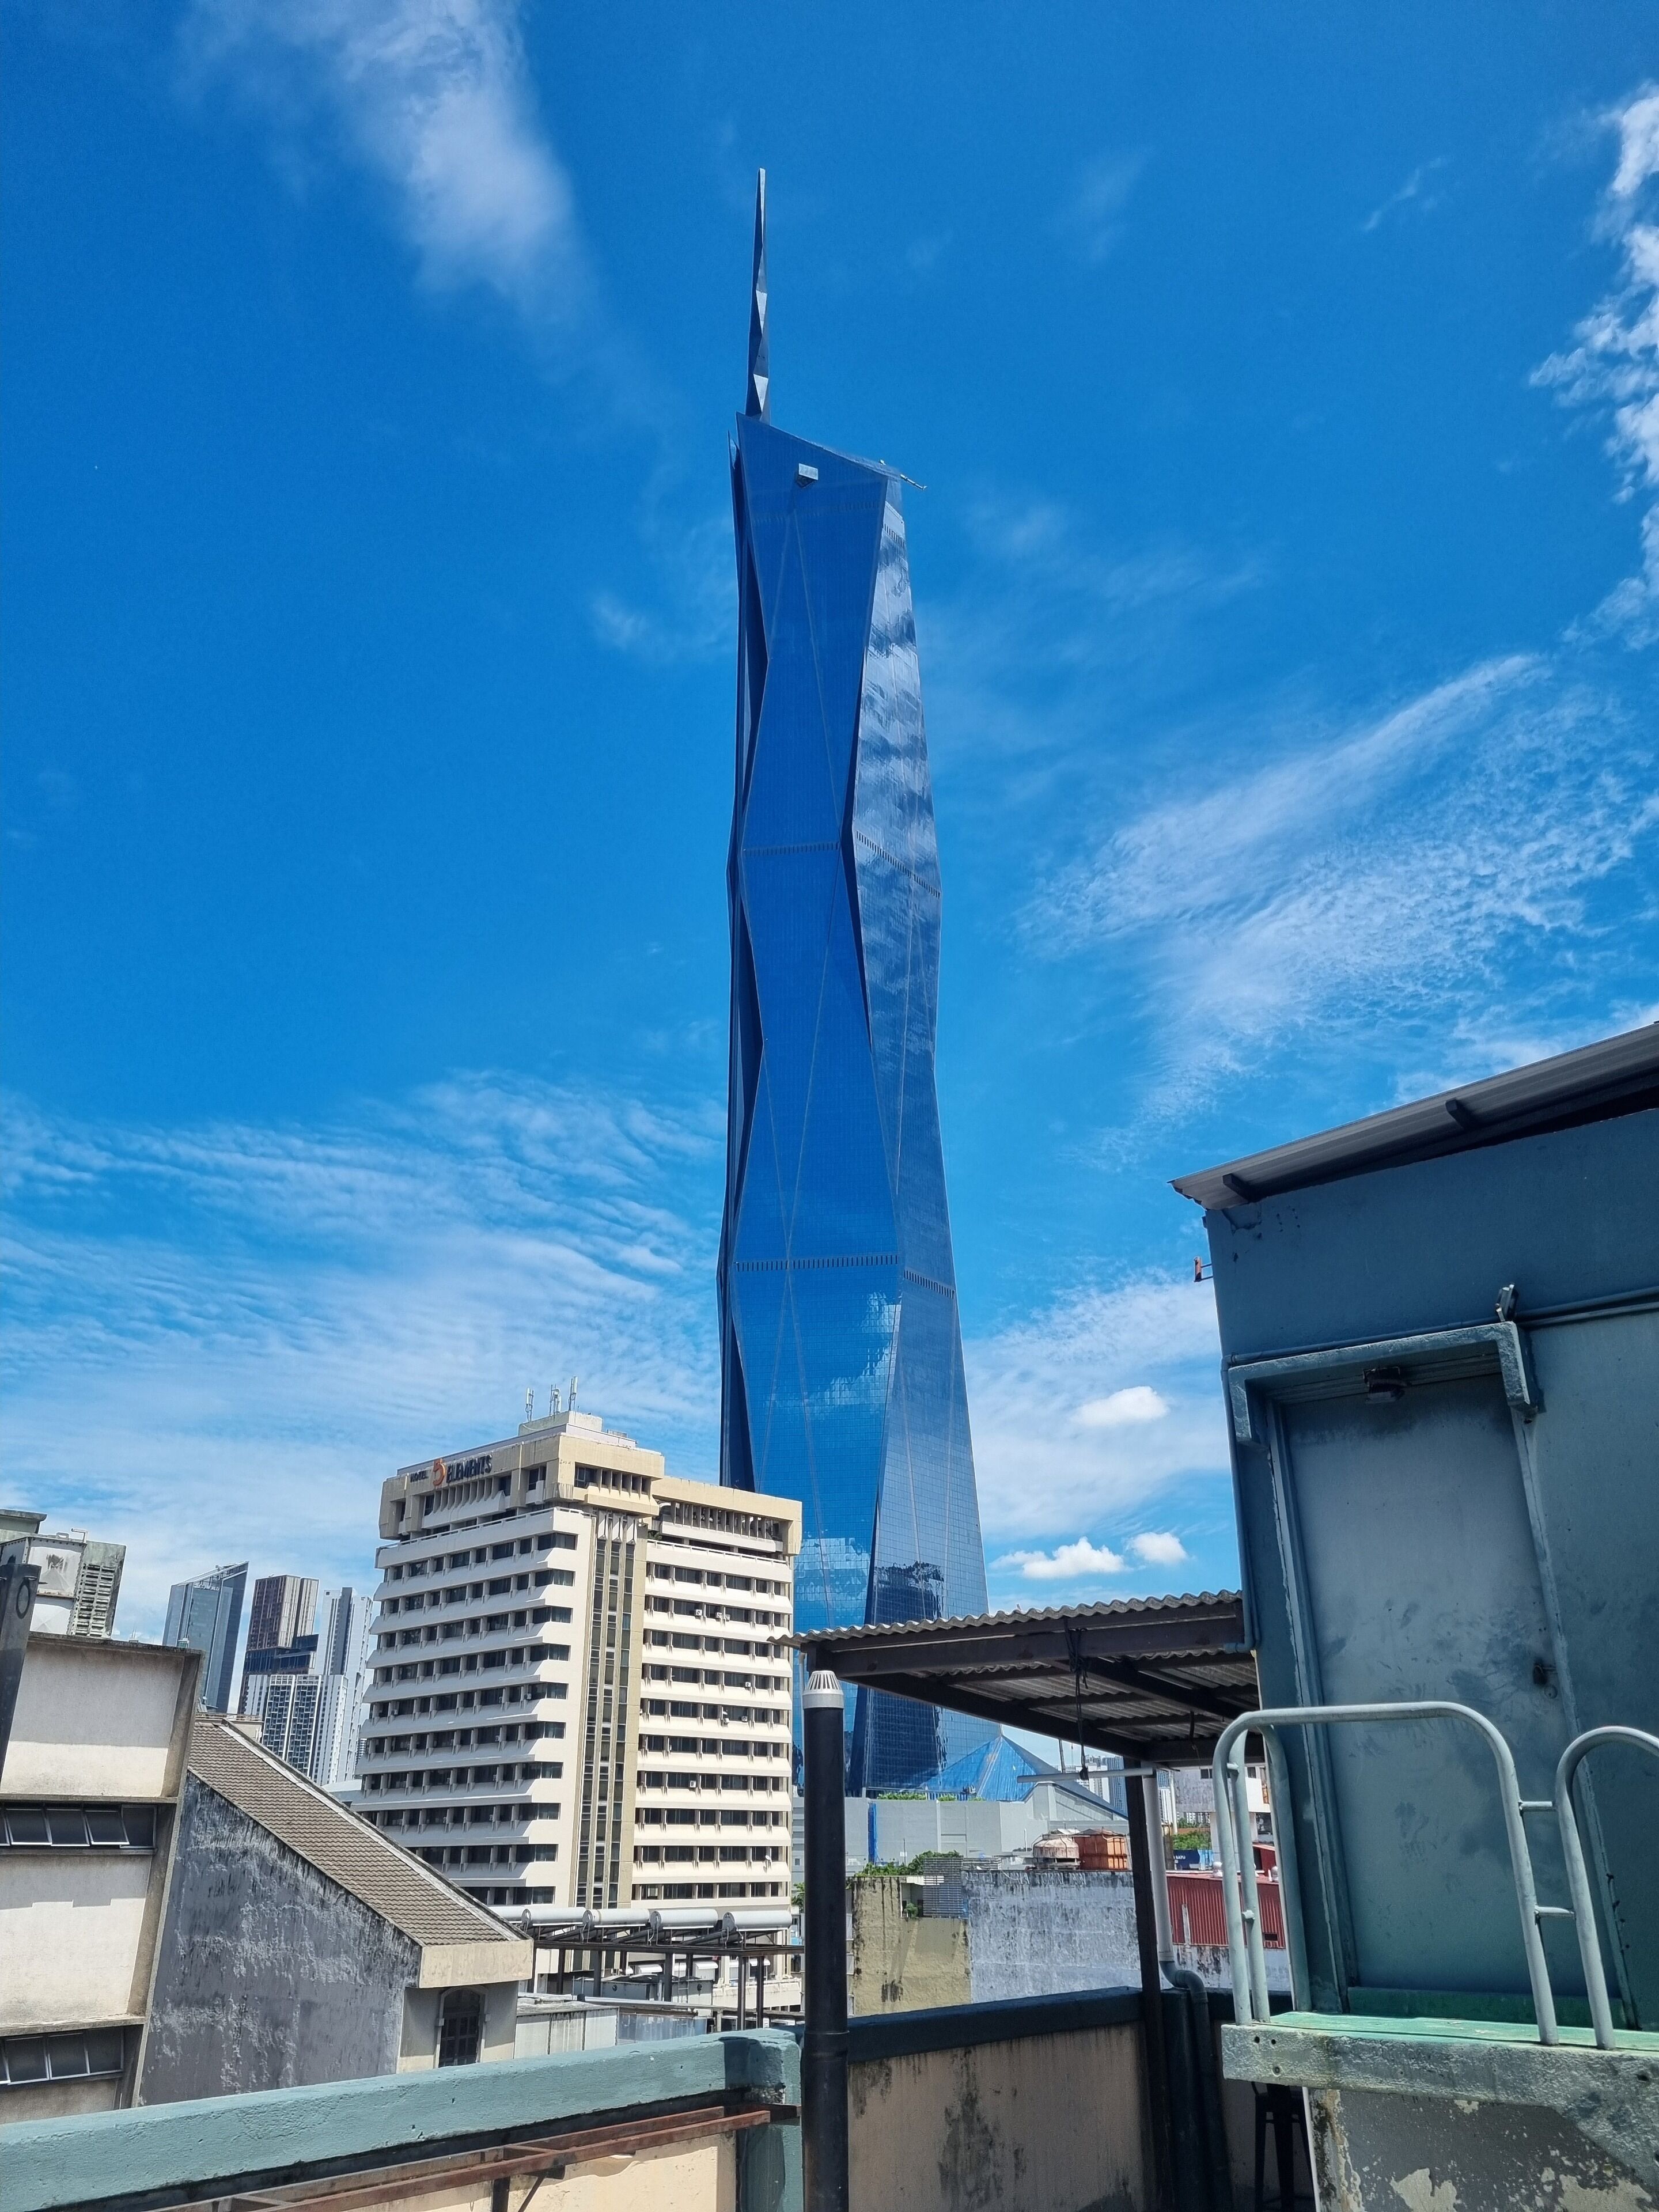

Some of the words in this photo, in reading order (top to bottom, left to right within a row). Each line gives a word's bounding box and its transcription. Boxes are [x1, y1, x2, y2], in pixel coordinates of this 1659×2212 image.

[410, 1469, 429, 1483] HOTEL
[433, 1459, 446, 1486] 5
[446, 1455, 493, 1483] ELEMENTS
